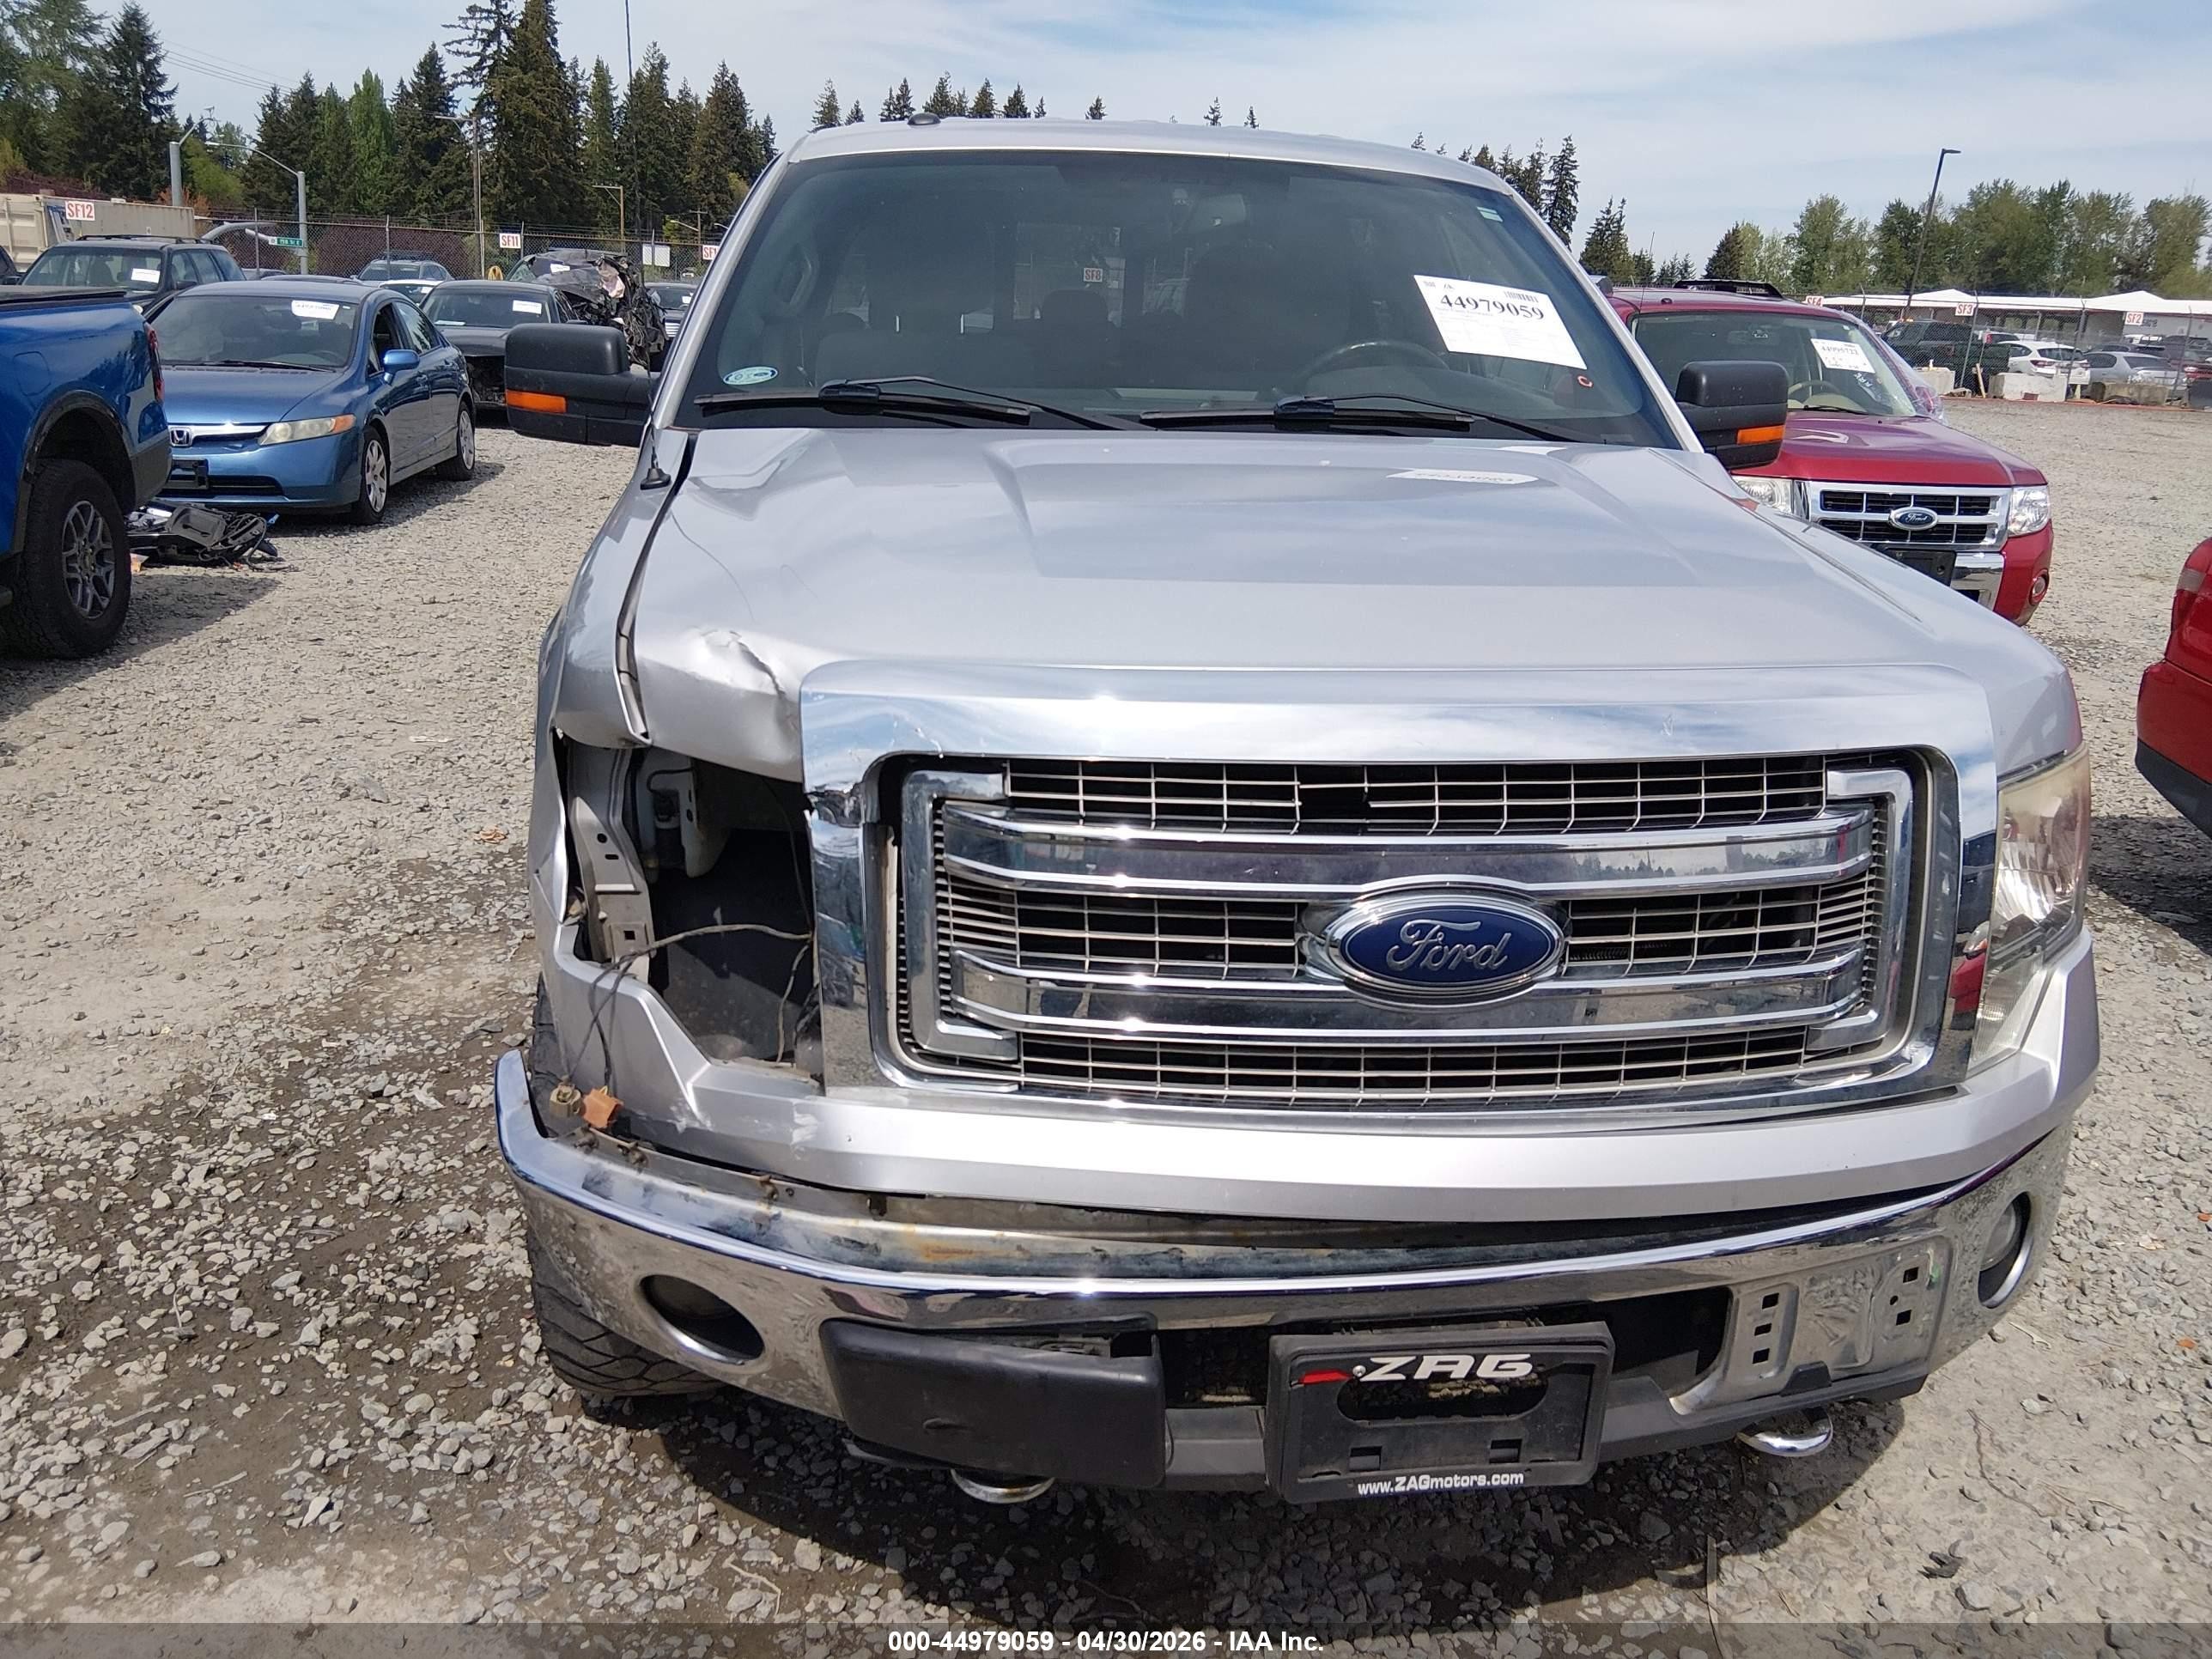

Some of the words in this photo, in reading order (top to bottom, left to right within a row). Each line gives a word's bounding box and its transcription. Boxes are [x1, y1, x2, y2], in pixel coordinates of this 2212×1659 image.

[67, 204, 94, 219] SF12
[501, 234, 519, 246] SF11
[703, 246, 717, 258] SF1
[1085, 269, 1101, 281] SF8
[1440, 294, 1545, 321] 44979059
[1807, 296, 1822, 307] SF4
[1957, 304, 1972, 314] SF3
[2127, 313, 2142, 324] SF2
[1905, 513, 1929, 523] Ford
[1386, 919, 1512, 971] Ford
[1359, 1353, 1533, 1382] ZAG
[1358, 1469, 1525, 1495] www.ZAGmotors.com
